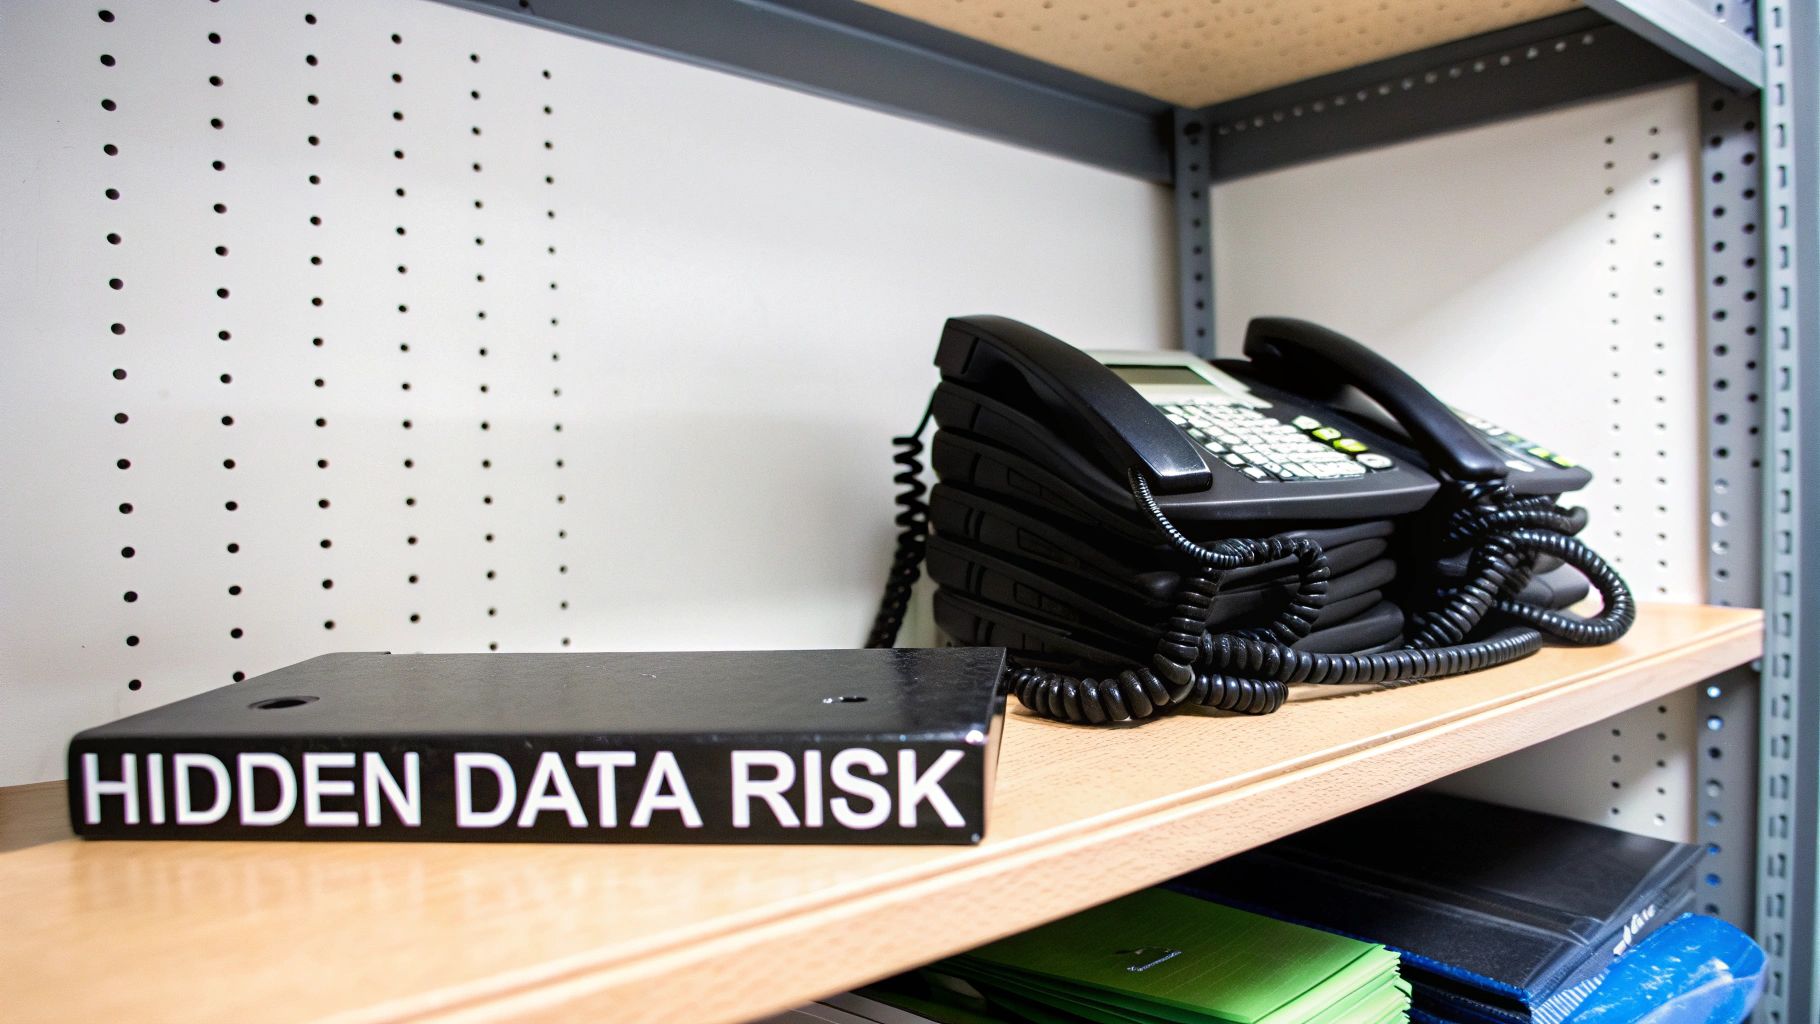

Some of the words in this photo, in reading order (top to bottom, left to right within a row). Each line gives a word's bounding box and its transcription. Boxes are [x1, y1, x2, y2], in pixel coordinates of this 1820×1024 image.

[84, 752, 421, 828] HIDDEN
[454, 750, 703, 829] DATA
[730, 747, 966, 829] RISK
